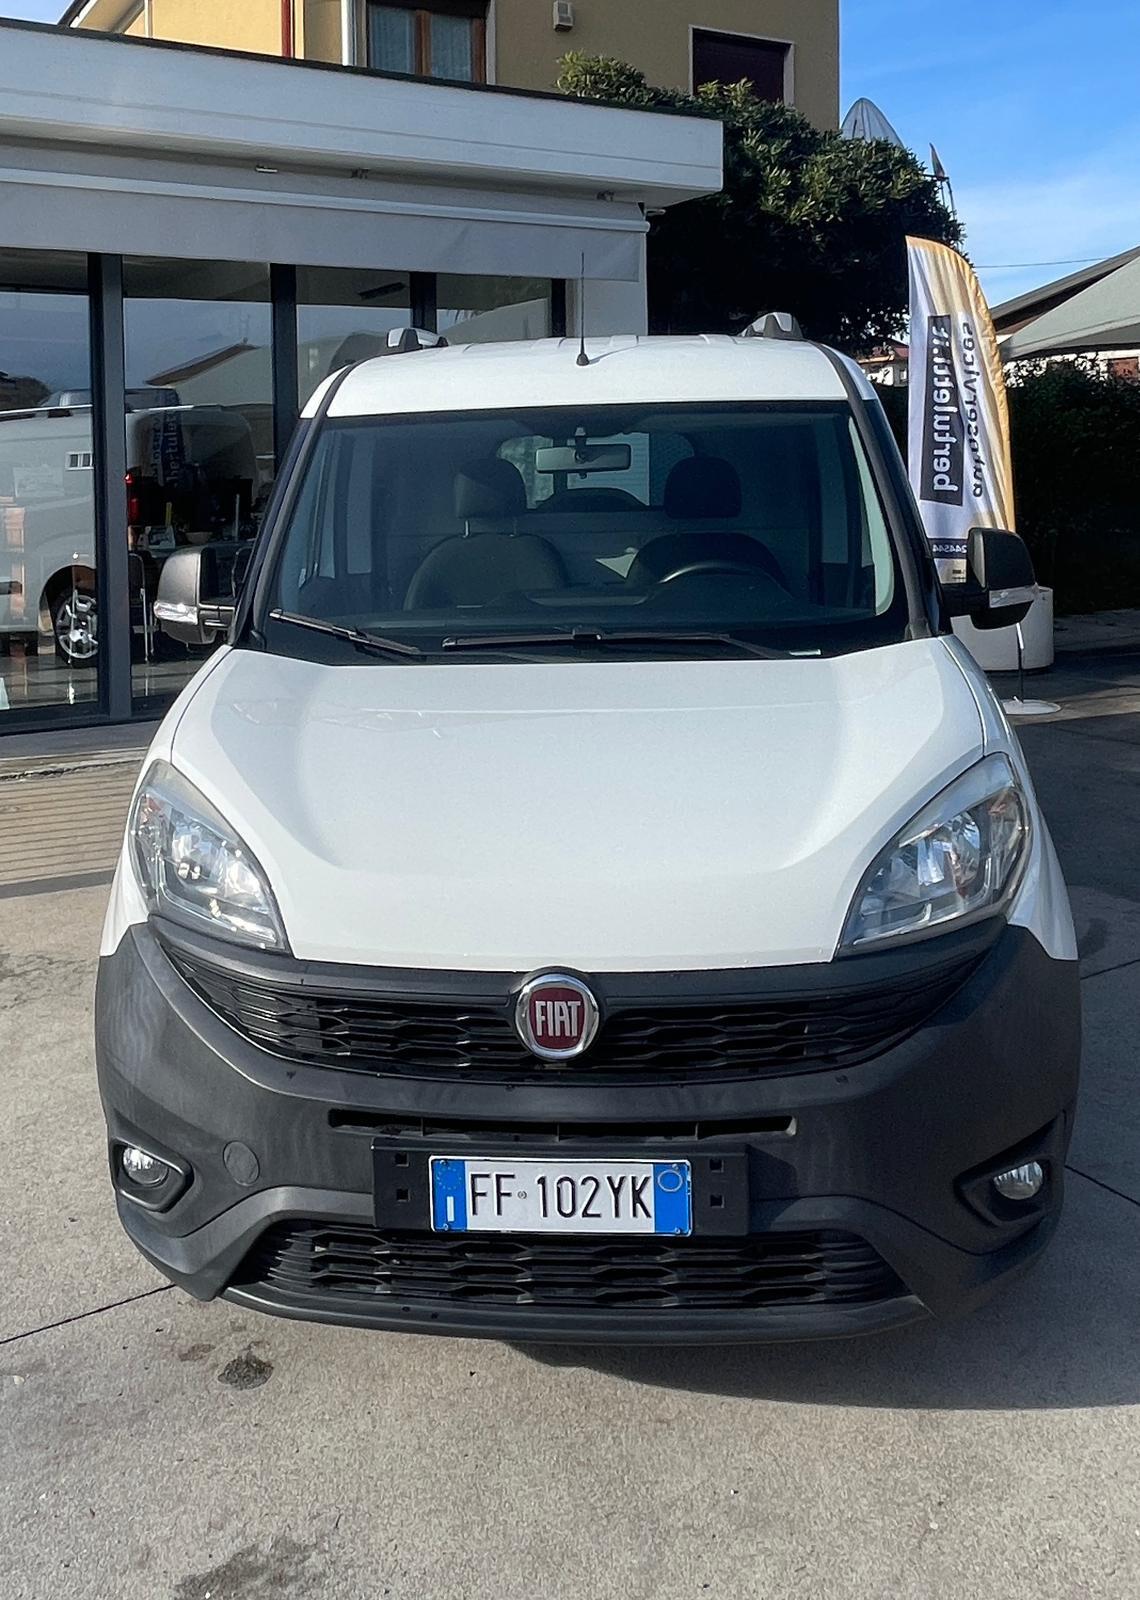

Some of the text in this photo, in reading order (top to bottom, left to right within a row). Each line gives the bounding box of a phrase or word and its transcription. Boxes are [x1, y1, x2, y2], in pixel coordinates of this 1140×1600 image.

[534, 1000, 582, 1037] FIAT
[469, 1173, 653, 1219] FF 102YK
